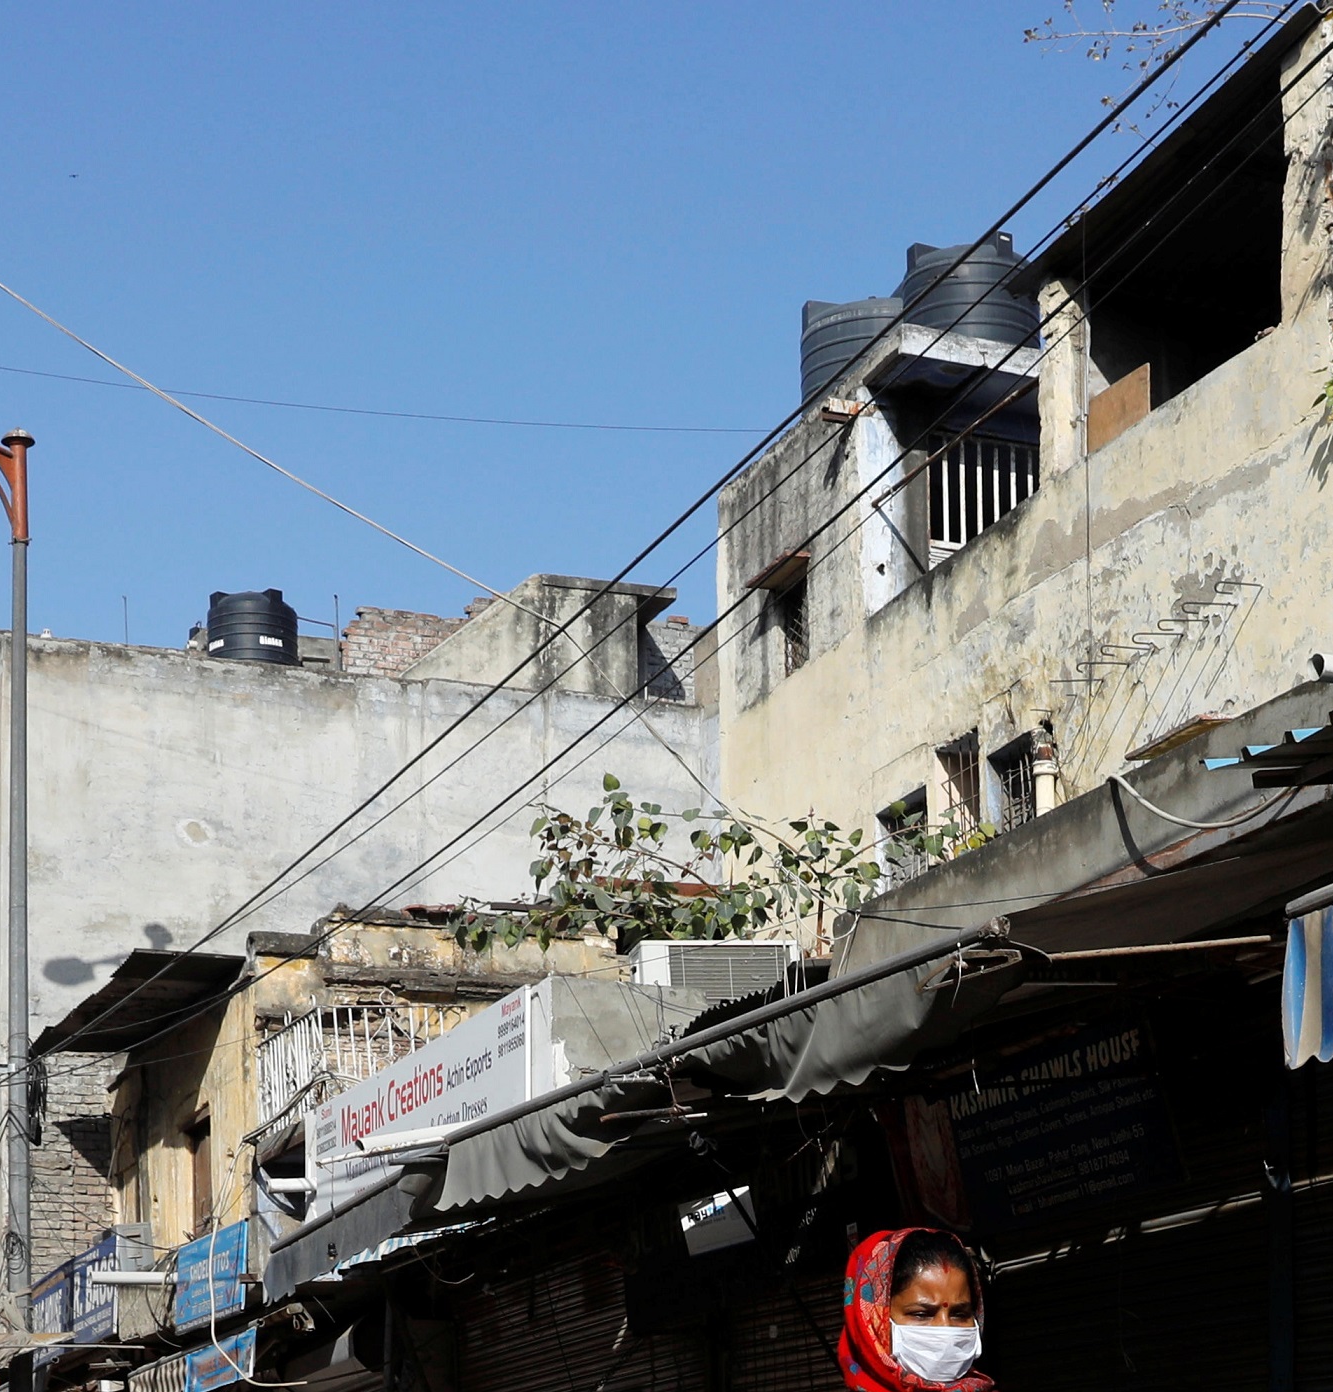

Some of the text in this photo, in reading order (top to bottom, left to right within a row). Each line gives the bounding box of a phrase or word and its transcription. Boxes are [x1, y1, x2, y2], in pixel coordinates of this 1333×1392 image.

[388, 1063, 443, 1122] Creations
[446, 1062, 465, 1092] Achin
[465, 1047, 492, 1083] Exports
[461, 1096, 488, 1122] Dresses
[950, 1027, 1140, 1121] KASHMIR SHAWLS HOUSE
